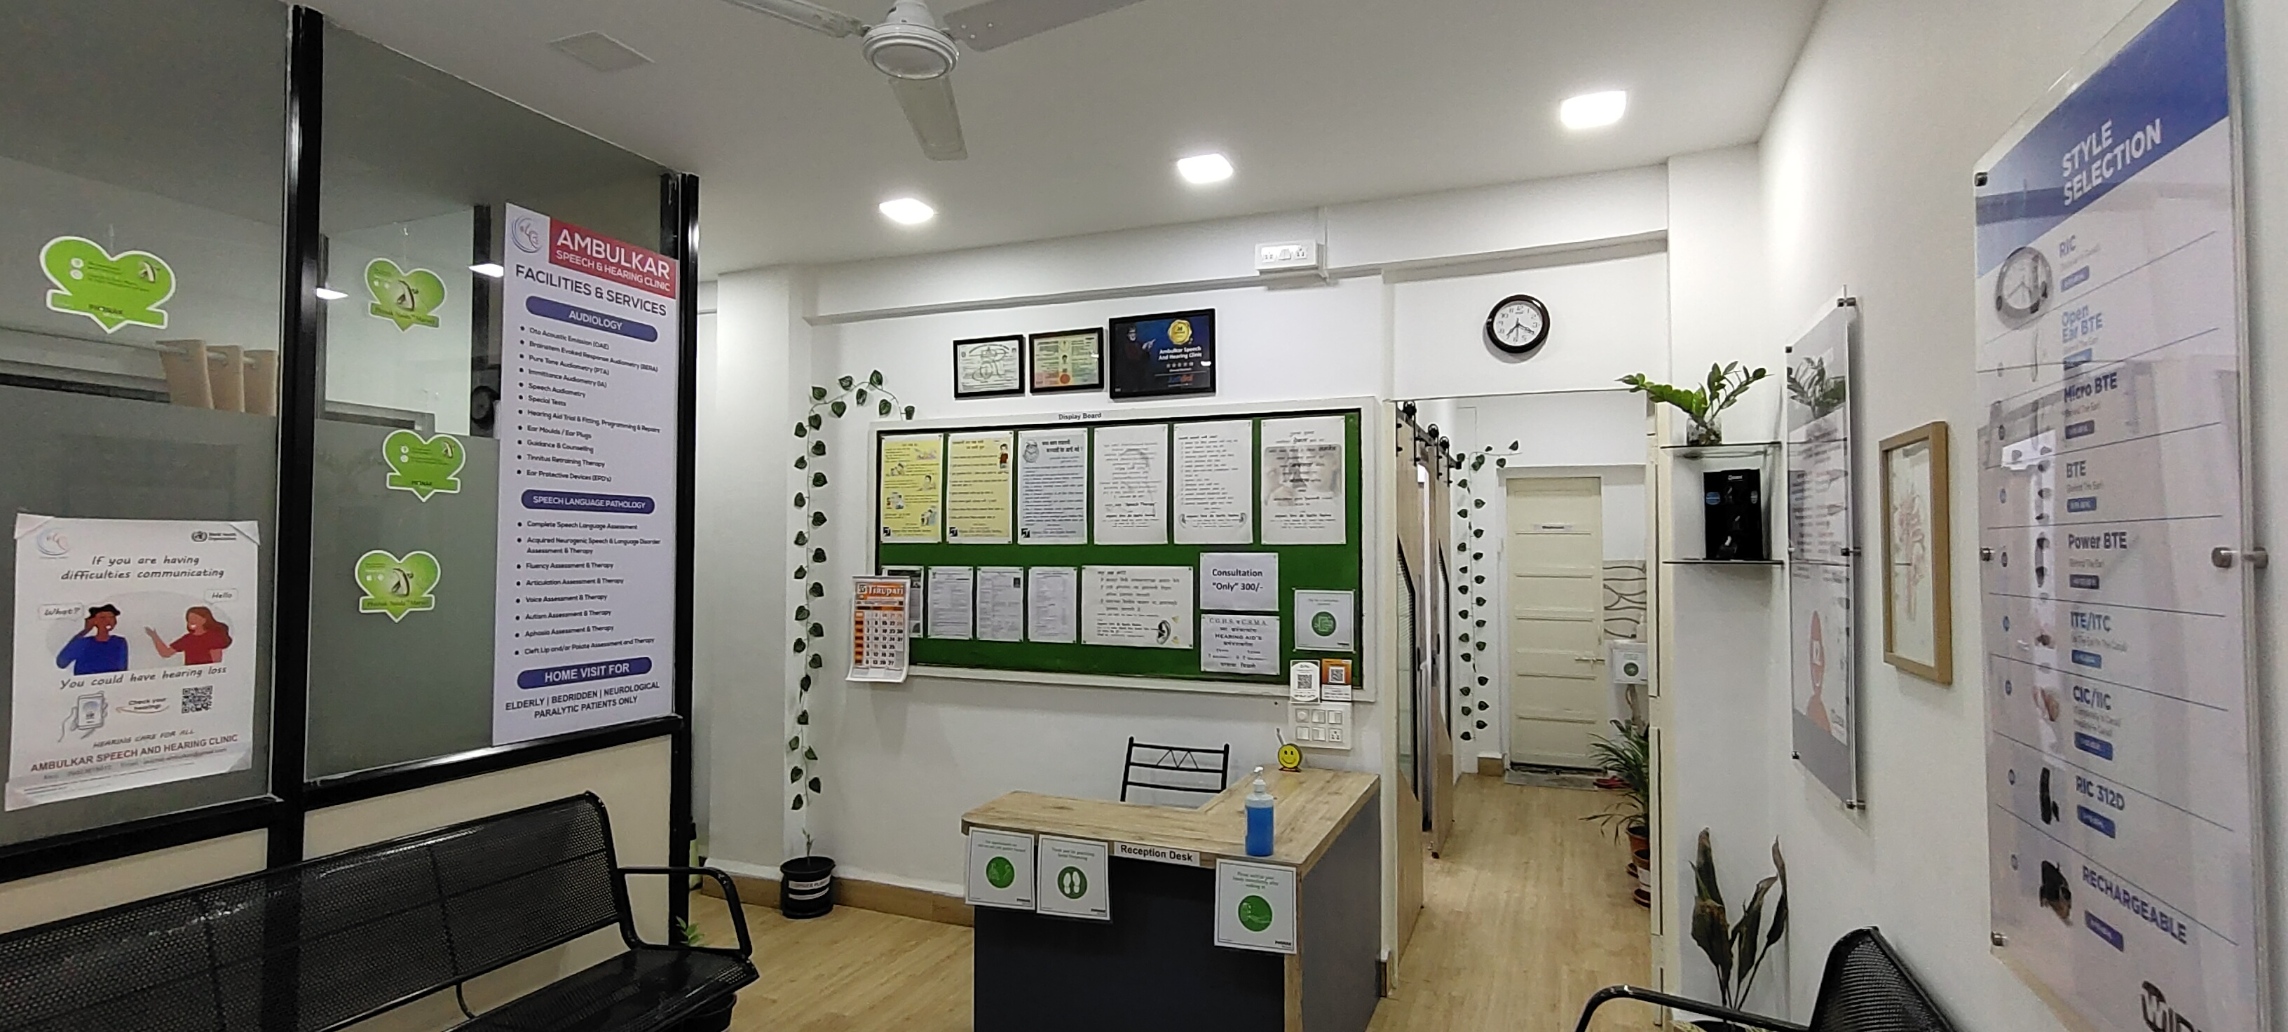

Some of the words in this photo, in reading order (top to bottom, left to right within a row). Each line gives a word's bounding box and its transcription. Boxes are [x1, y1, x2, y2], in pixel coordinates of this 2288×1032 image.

[2062, 119, 2112, 177] STYLE
[2064, 119, 2161, 206] SELECTION
[557, 229, 670, 279] AMBULKAR
[2059, 235, 2076, 258] RIC
[557, 250, 594, 269] SPEECH
[597, 263, 603, 271] &
[605, 265, 643, 283] HEARING
[645, 277, 670, 291] CLINIC
[516, 264, 592, 296] FACILITIES
[595, 287, 603, 299] &
[606, 290, 667, 316] SERVICES
[569, 310, 622, 330] AUDIOLOGY
[2062, 304, 2089, 327] Open
[542, 330, 566, 341] Acoustic
[568, 336, 592, 346] Emission
[2062, 327, 2078, 344] Ear
[2080, 313, 2103, 335] BTE
[529, 355, 543, 363] Pure
[545, 358, 558, 366] Tone
[560, 361, 593, 373] Audiometry
[594, 367, 609, 375] (PTA)
[561, 348, 582, 357] Evoked
[583, 352, 609, 362] Response
[610, 358, 639, 370] Audiometry
[528, 383, 551, 392] Speech
[552, 387, 586, 398] Audiometry
[563, 375, 596, 387] Audiometry
[2064, 382, 2092, 403] Micro
[2094, 372, 2118, 394] BTE
[528, 396, 550, 405] Special
[528, 410, 551, 420] Hearing
[564, 414, 576, 422] Trial
[602, 420, 636, 432] Programming
[539, 427, 560, 435] Moulds
[576, 431, 592, 439] Plugs
[527, 440, 555, 448] Guidance
[562, 443, 594, 453] Counselling
[527, 454, 550, 462] Tinnitus
[552, 456, 581, 467] Retraining
[582, 460, 605, 468] Therapy
[2067, 460, 2086, 478] BTE
[539, 471, 568, 479] Protective
[533, 496, 563, 504] SPEECH
[565, 498, 604, 507] LANGUAGE
[606, 500, 645, 508] PATHOLOGY
[527, 521, 556, 529] Complete
[557, 522, 578, 530] Speech
[527, 537, 554, 545] Acquired
[2068, 534, 2100, 550] Power
[2104, 532, 2127, 549] BTE
[109, 557, 130, 566] you
[138, 556, 156, 564] are
[164, 556, 199, 566] having
[61, 570, 130, 580] difficulties
[137, 569, 224, 579] communicating
[1212, 569, 1262, 577] Consultation
[1241, 583, 1263, 591] 300/-
[44, 607, 81, 616] What?
[2071, 611, 2111, 632] ITE/ITC
[525, 630, 550, 638] Aphasia
[551, 627, 585, 635] Assessment
[525, 647, 539, 655] Cleft
[551, 644, 570, 653] and/or
[591, 640, 622, 648] Assessment
[60, 679, 84, 690] You
[91, 674, 123, 686] could
[130, 672, 156, 682] have
[162, 668, 202, 679] hearing
[208, 666, 227, 675] loss
[545, 669, 577, 683] HOME
[580, 665, 606, 678] VISIT
[609, 663, 629, 674] FOR
[506, 698, 545, 710] ELDERLY
[552, 690, 597, 703] BEDRIDDEN
[604, 682, 660, 696] NEUROLOGICAL
[2073, 685, 2111, 710] CIC/IIC
[534, 705, 579, 718] PARALYTIC
[581, 700, 617, 711] PATIENTS
[619, 696, 638, 705] ONLY
[93, 737, 131, 748] HEARING
[135, 734, 156, 742] CARE
[31, 756, 93, 772] AMBULKAR
[96, 749, 138, 762] SPEECH
[140, 745, 161, 756] AND
[164, 739, 206, 753] HEARING
[209, 734, 238, 745] CLINIC
[2076, 775, 2094, 797] RIC
[2097, 784, 2125, 811] 312D
[1121, 845, 1166, 858] Reception
[1169, 851, 1193, 862] Desk
[2082, 865, 2187, 945] RECHARGEABLE
